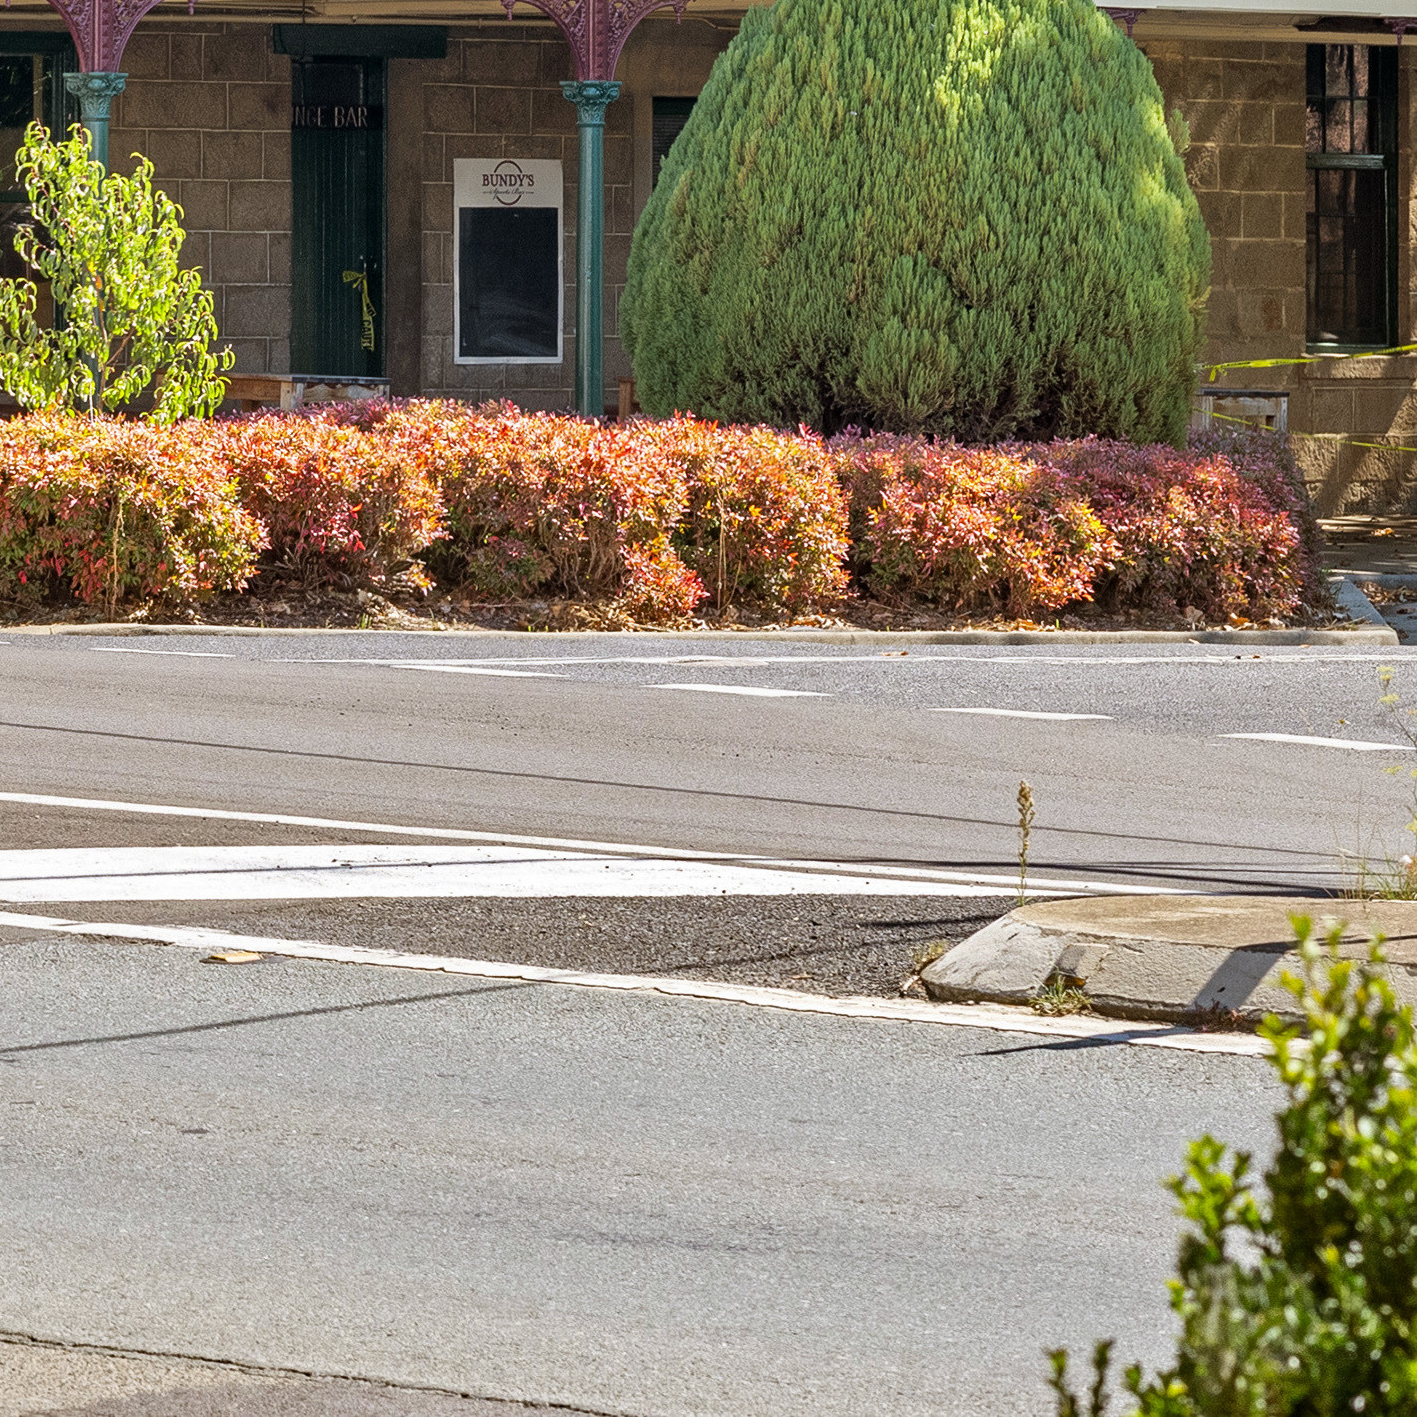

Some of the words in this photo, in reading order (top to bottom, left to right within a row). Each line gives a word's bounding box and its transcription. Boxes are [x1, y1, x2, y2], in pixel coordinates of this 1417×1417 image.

[292, 105, 327, 127] NGE
[334, 105, 369, 128] BAR
[481, 173, 535, 187] BUNDY'S
